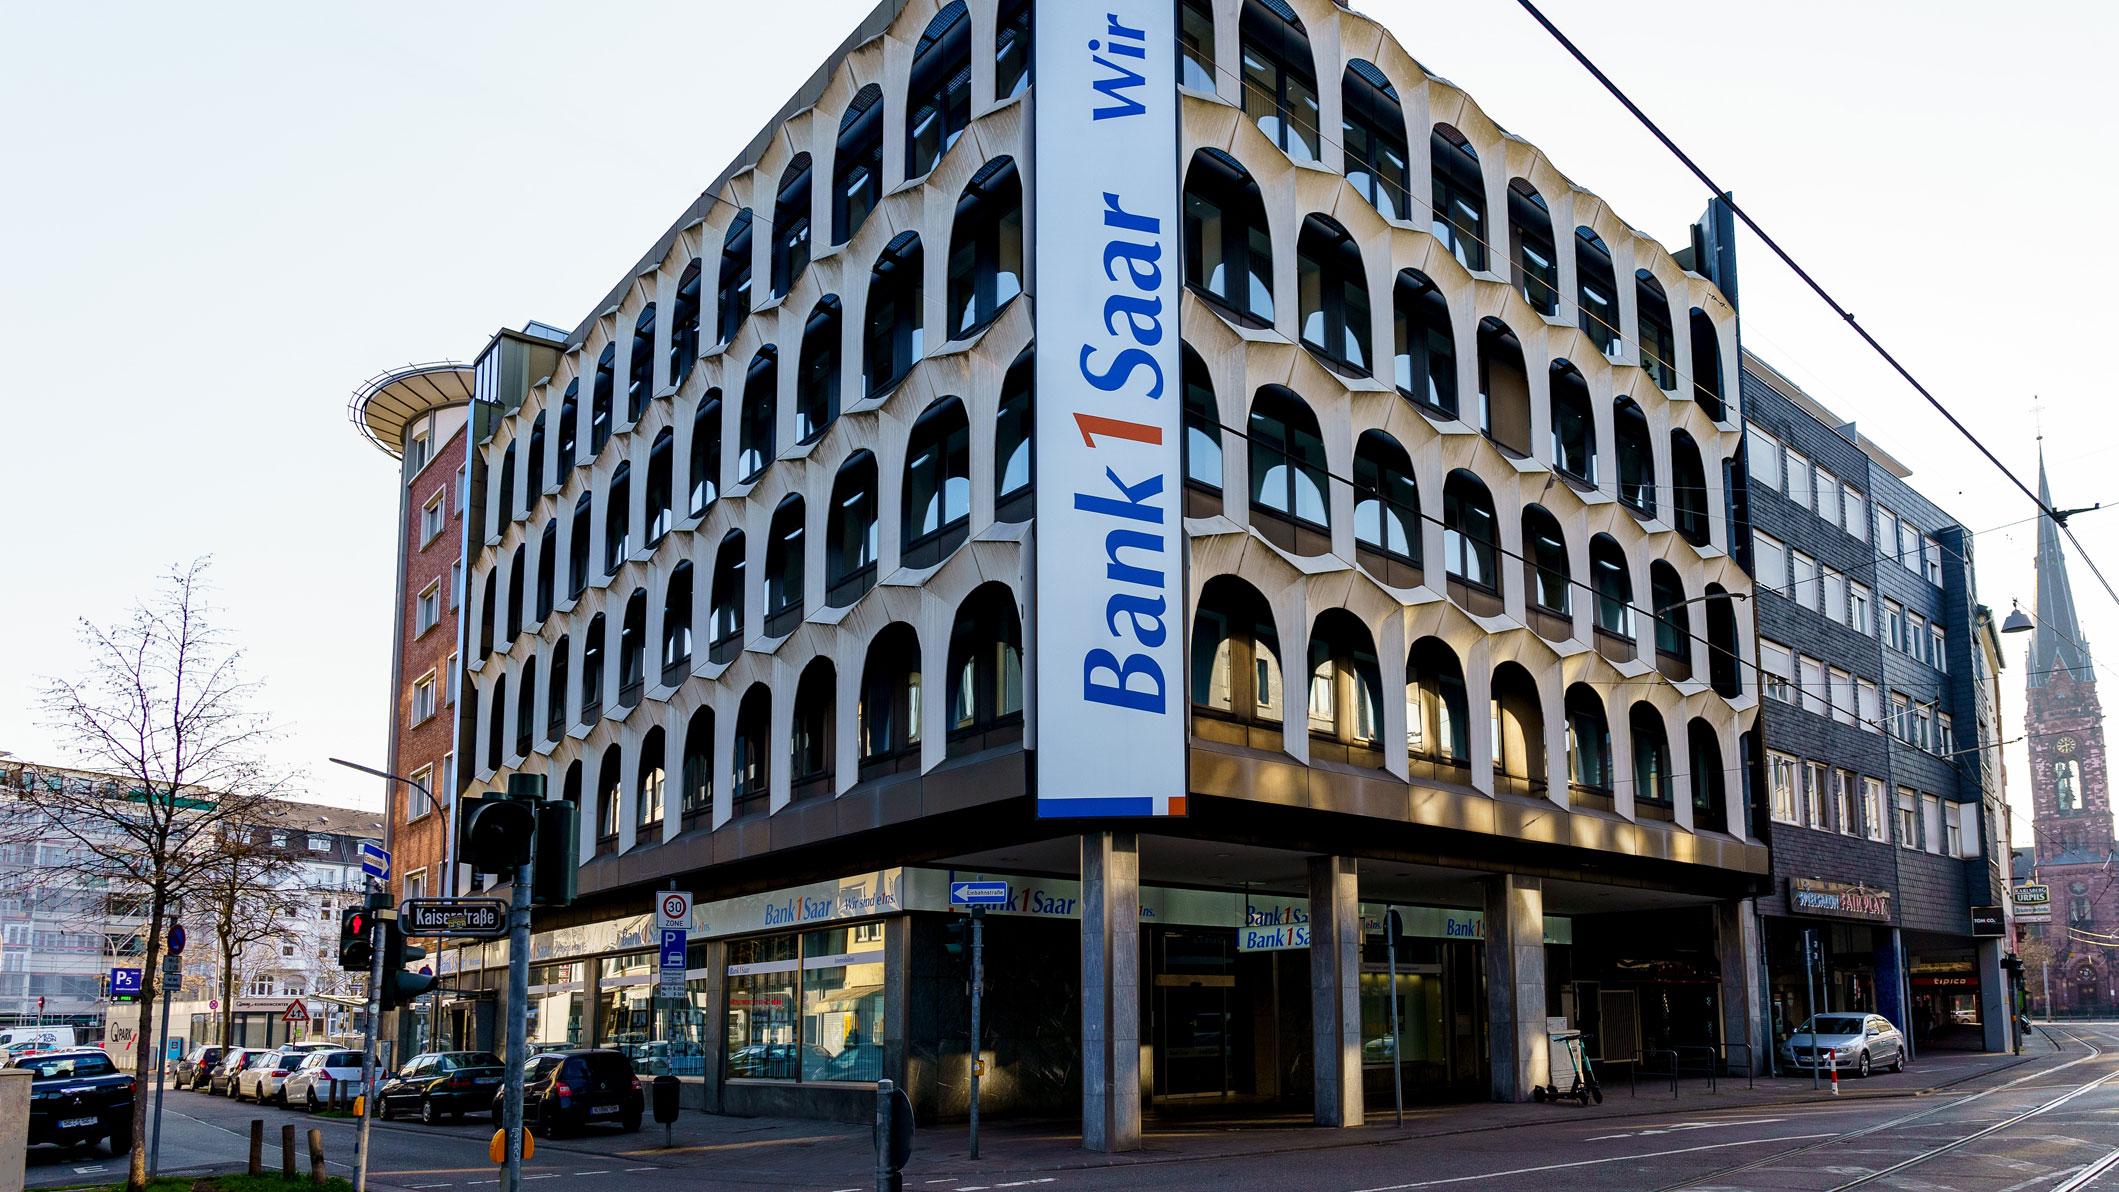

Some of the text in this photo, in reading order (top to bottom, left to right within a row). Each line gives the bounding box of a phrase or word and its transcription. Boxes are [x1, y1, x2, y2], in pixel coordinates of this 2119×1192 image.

[1088, 12, 1147, 122] Wir
[844, 896, 858, 911] Wir
[859, 893, 875, 909] sind
[965, 886, 1076, 915] k1Saar
[1840, 889, 1863, 912] FAIR
[1864, 895, 1886, 915] PLAY
[2017, 893, 2046, 901] URPILS
[668, 901, 682, 913] 30
[1247, 905, 1309, 926] Bank1Sa
[416, 907, 495, 927] Kaisetraße
[1447, 918, 1486, 937] Bank1
[665, 932, 676, 948] P
[1247, 927, 1311, 949] Bank1Sa
[1933, 977, 1967, 986] tipico
